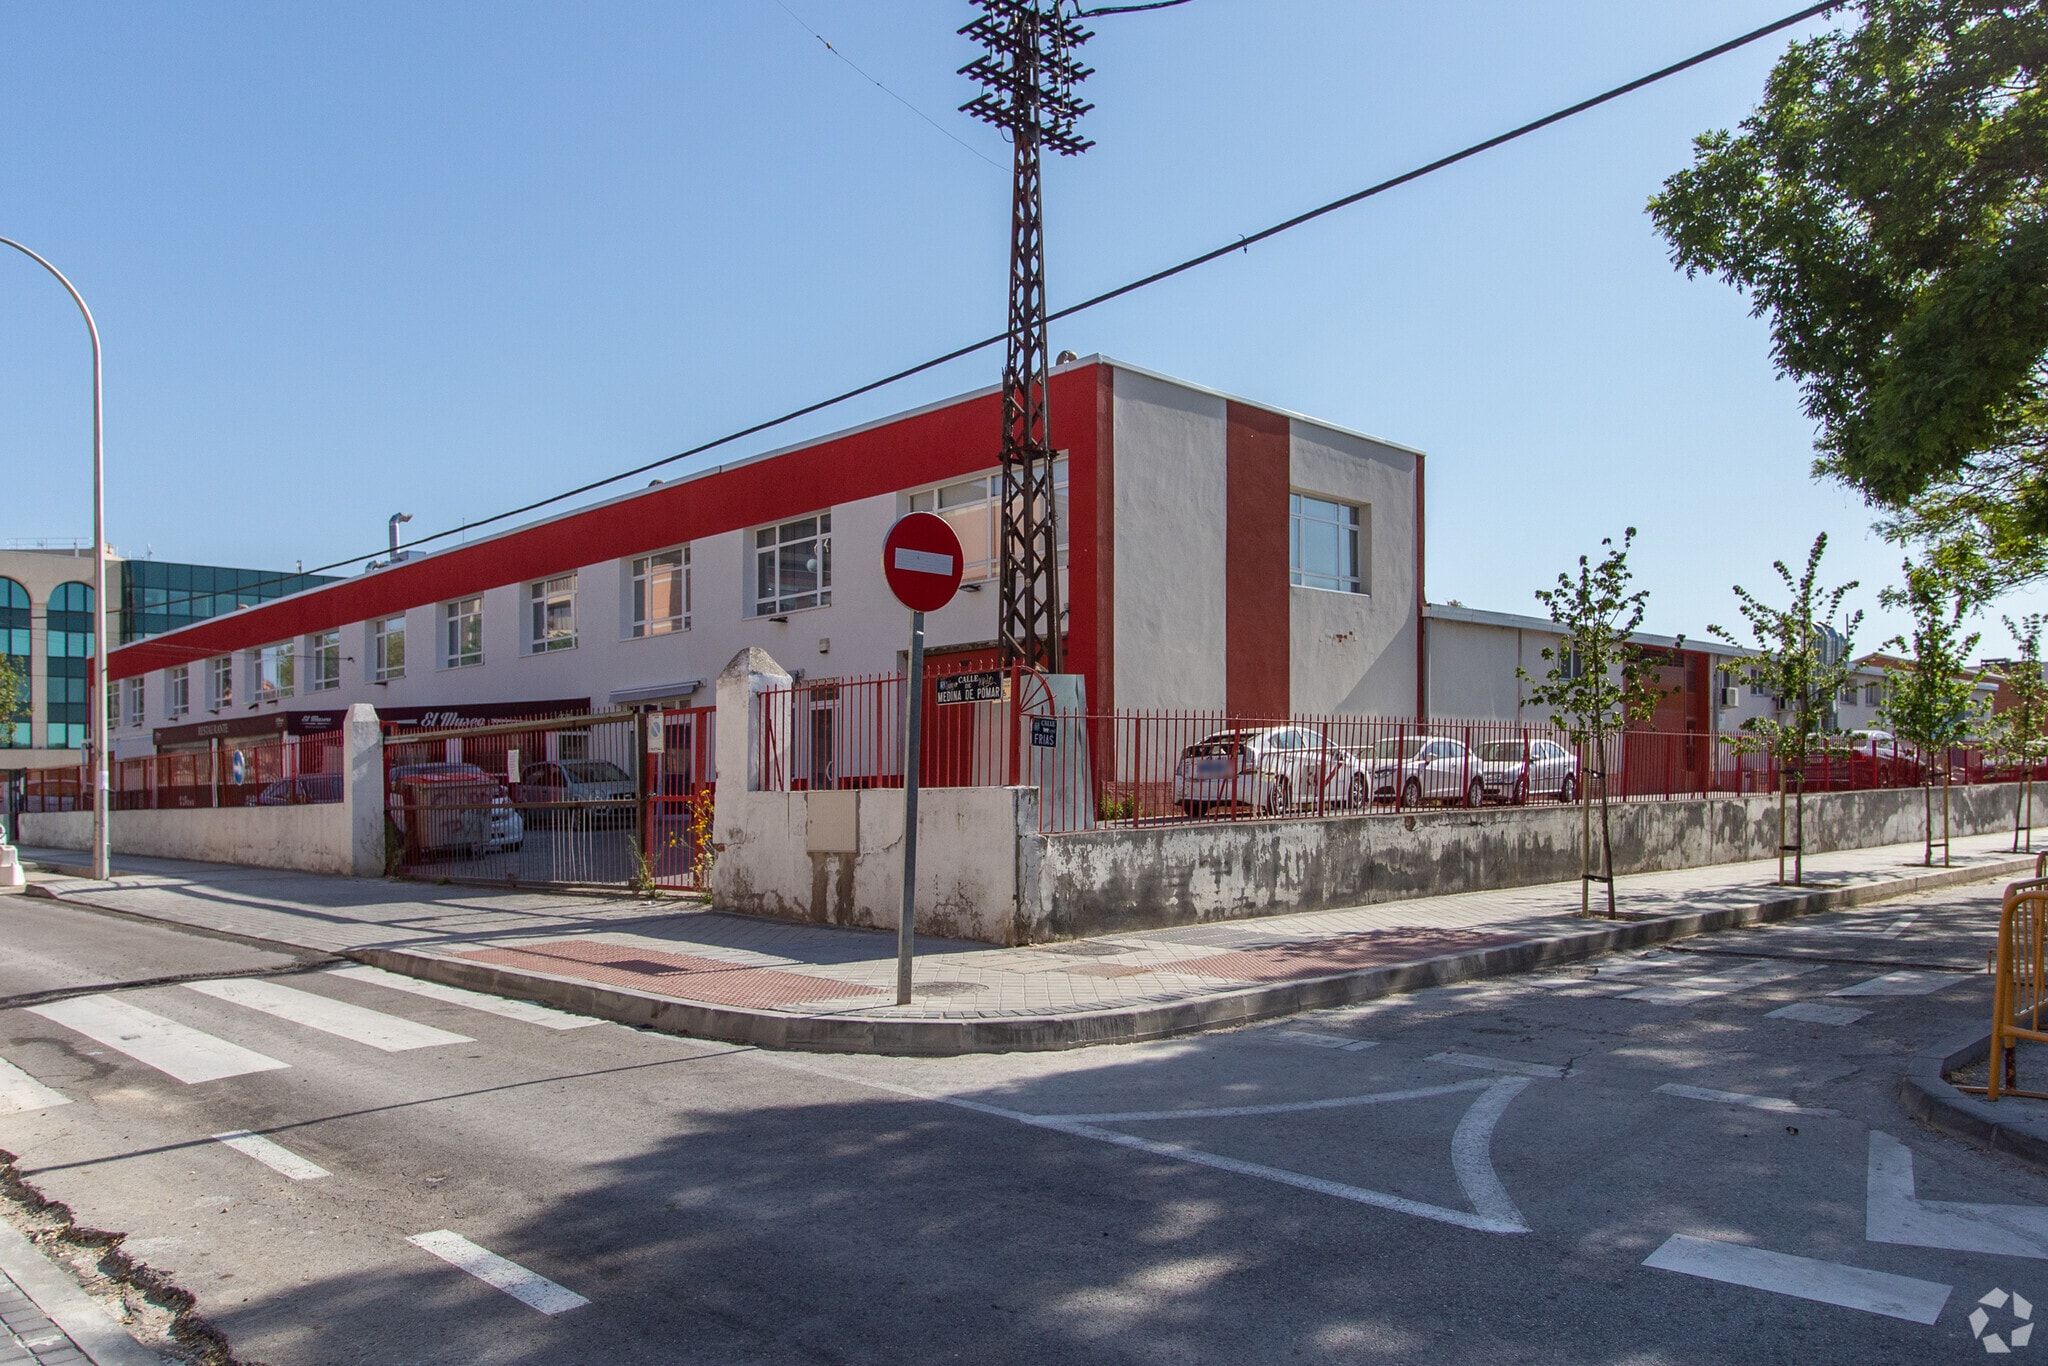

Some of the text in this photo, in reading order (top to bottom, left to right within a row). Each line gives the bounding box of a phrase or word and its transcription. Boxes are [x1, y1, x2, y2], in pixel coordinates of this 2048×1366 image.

[957, 674, 979, 684] CALLE
[937, 690, 962, 703] MEDINA
[965, 689, 975, 700] DE
[976, 686, 1000, 699] POMAR
[421, 711, 440, 727] El
[440, 711, 486, 727] Museo
[1040, 719, 1056, 727] CALLE
[197, 723, 229, 736] RESTAURANTE
[1033, 733, 1055, 746] FRIAS
